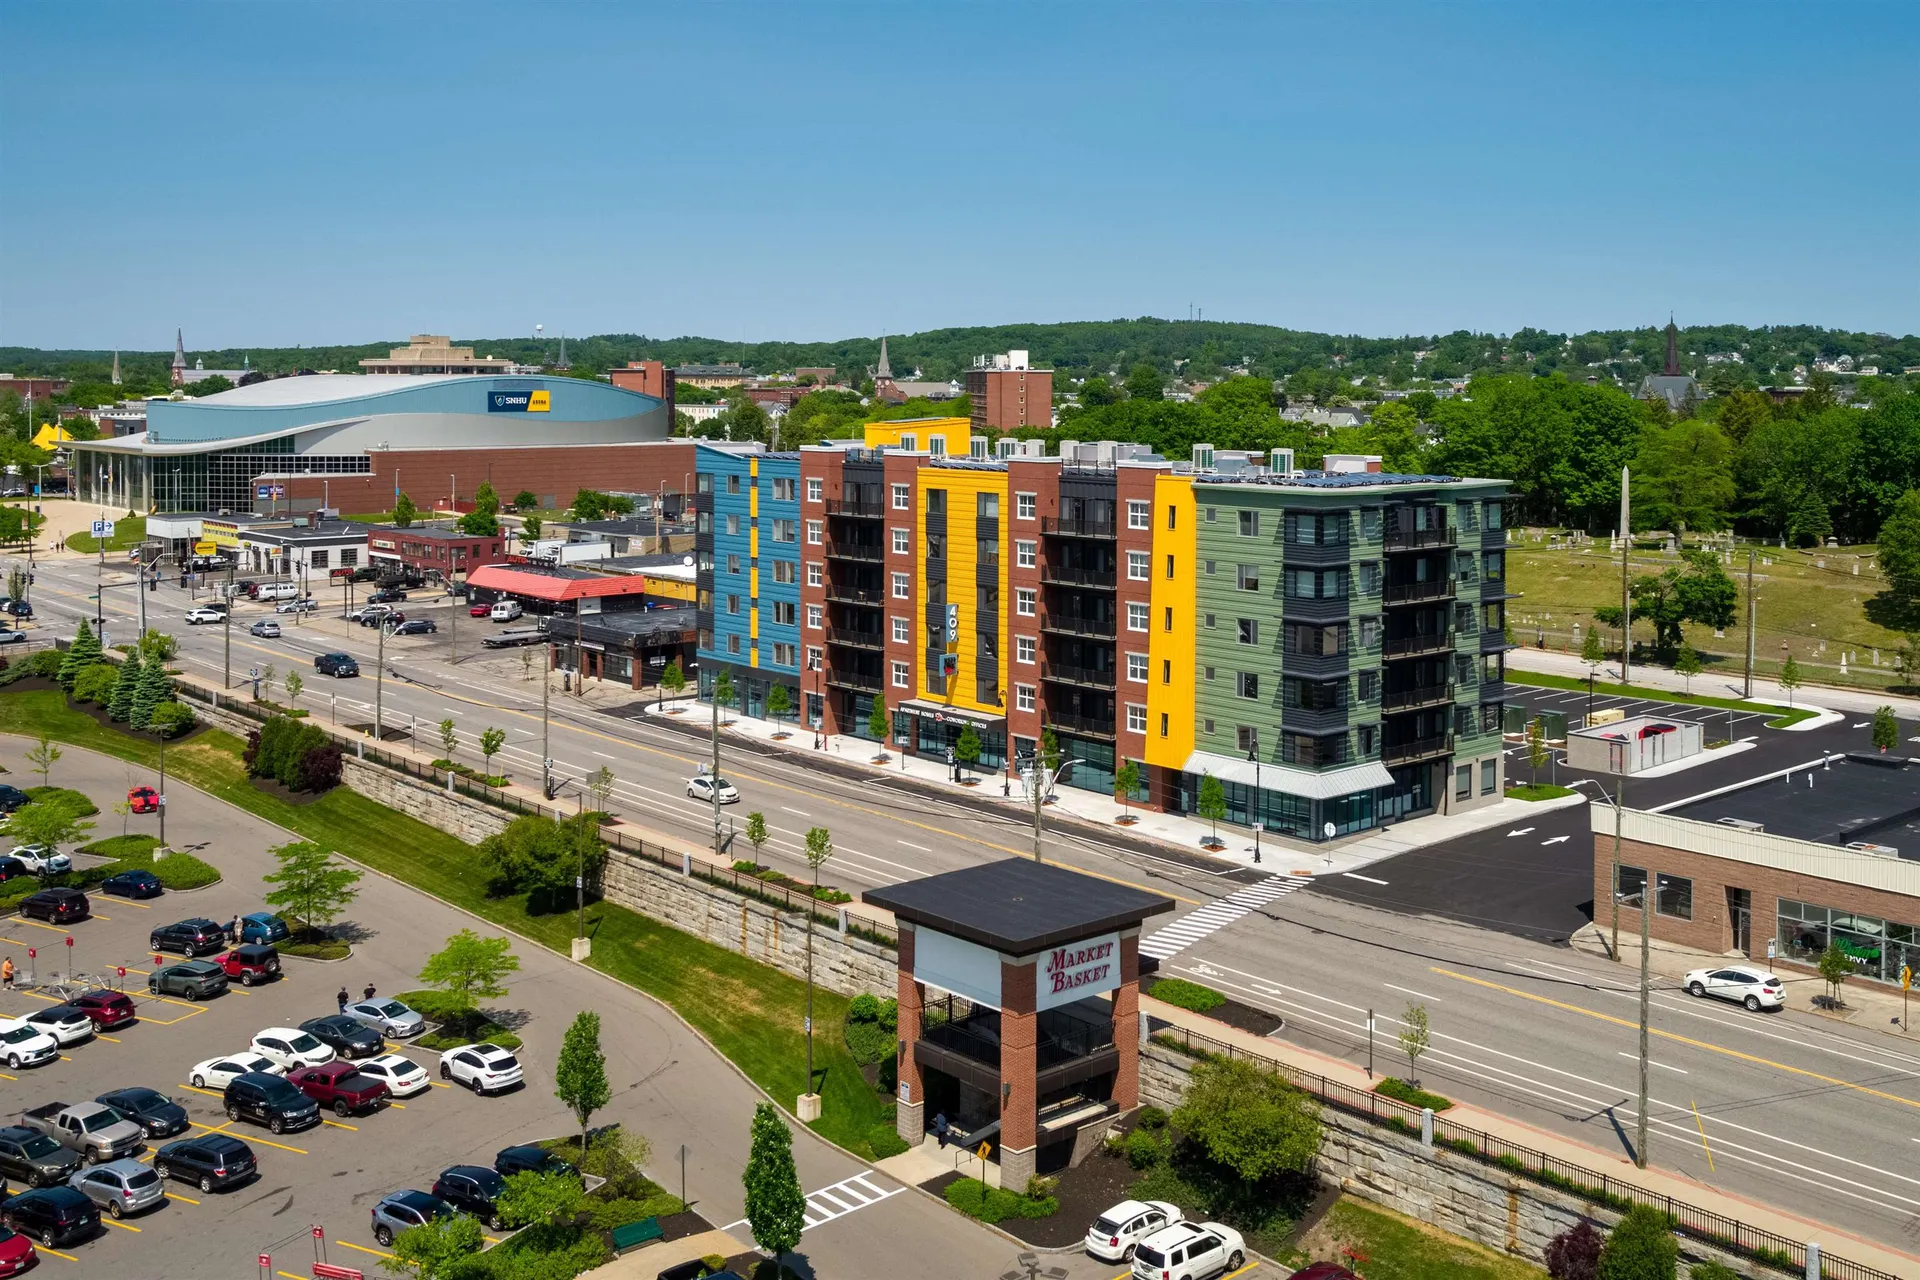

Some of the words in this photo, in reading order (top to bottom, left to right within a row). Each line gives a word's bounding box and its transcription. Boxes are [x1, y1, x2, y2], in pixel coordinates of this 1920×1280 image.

[949, 606, 957, 640] 409
[1045, 942, 1113, 972] MARKET
[1050, 964, 1110, 994] BASKET
